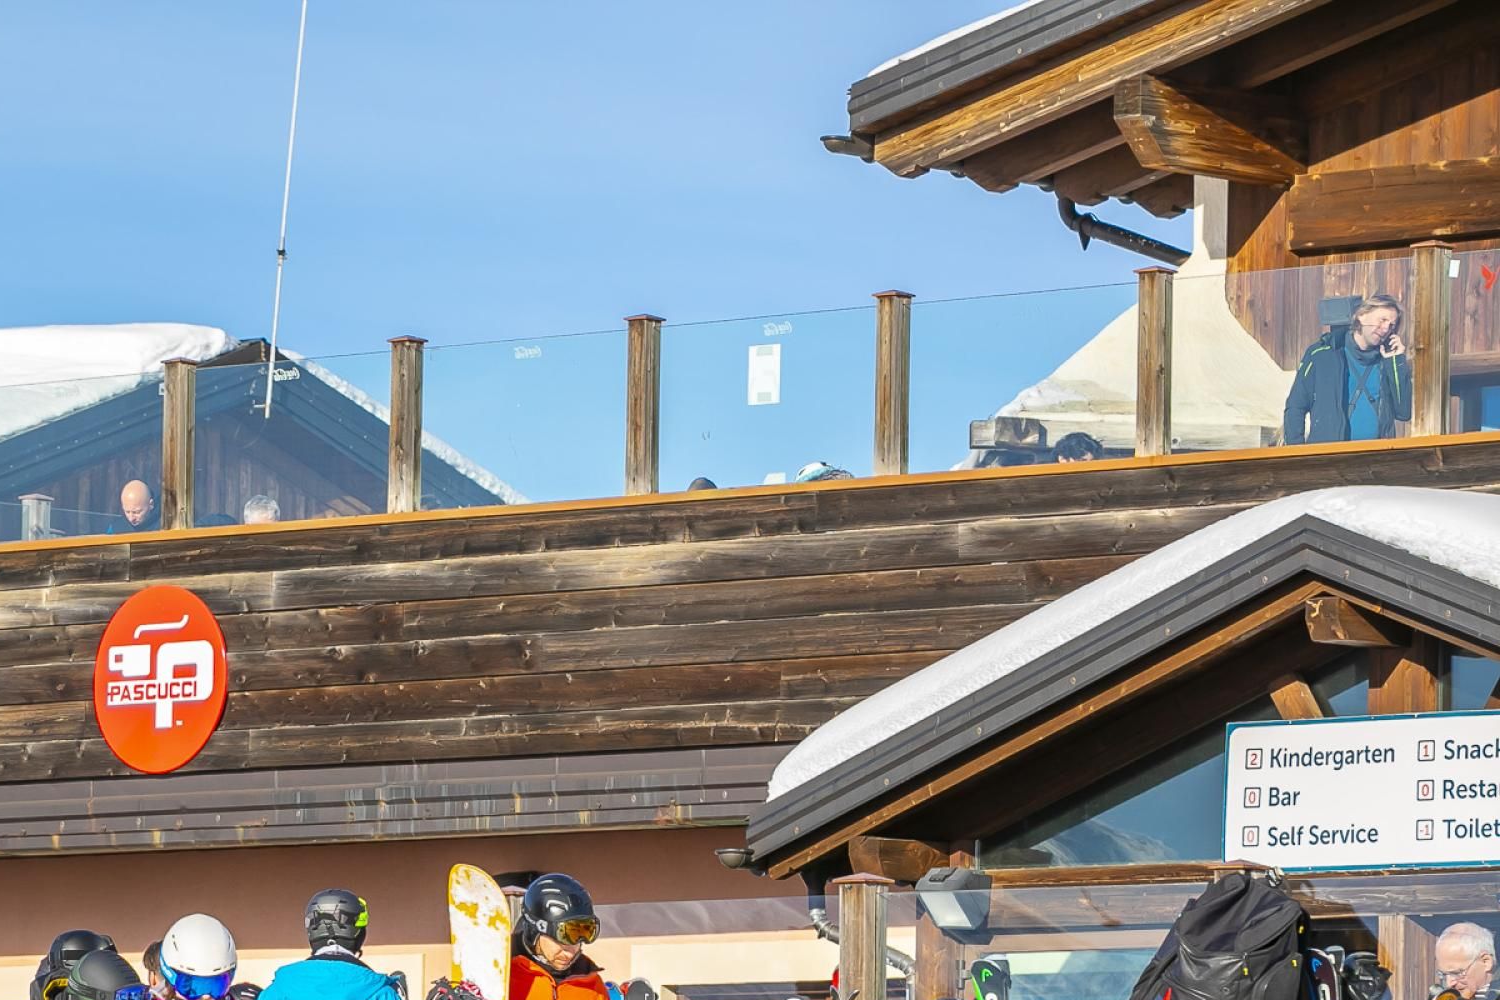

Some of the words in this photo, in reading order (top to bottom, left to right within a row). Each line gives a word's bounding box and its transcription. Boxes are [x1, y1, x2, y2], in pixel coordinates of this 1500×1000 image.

[109, 680, 197, 702] PASCUCCI
[1250, 753, 1258, 766] 2
[1270, 746, 1395, 770] Kindergarten
[1422, 744, 1430, 757] 1
[1248, 791, 1256, 804] 0
[1268, 787, 1300, 807] Bar
[1421, 784, 1429, 797] 0
[1442, 779, 1500, 800] Resta
[1247, 830, 1254, 843] 0
[1267, 826, 1304, 846] Self
[1309, 824, 1379, 845] Service
